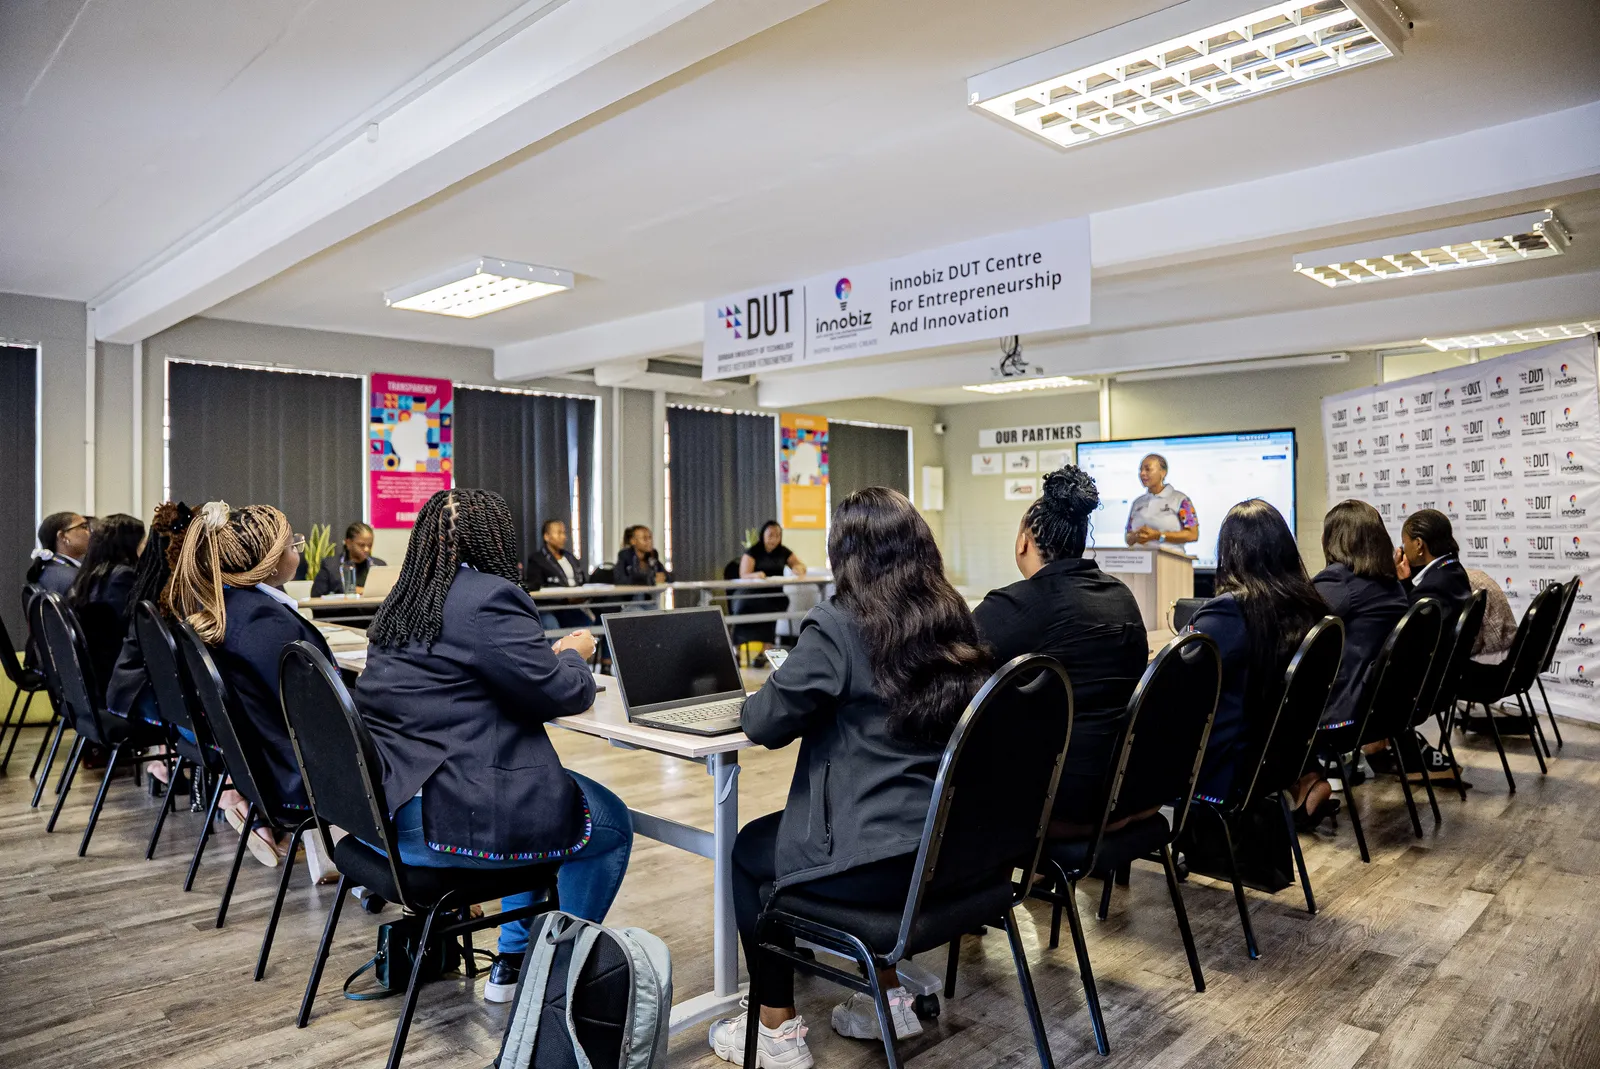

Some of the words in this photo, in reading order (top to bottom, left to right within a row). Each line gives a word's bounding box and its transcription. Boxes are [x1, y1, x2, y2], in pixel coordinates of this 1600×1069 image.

[890, 269, 944, 292] innobiz
[948, 261, 981, 280] DUT
[985, 252, 1042, 273] Centre
[890, 299, 913, 314] For
[918, 271, 1062, 306] Entrepreneurship
[747, 289, 794, 340] DUT
[816, 310, 872, 333] innobiz
[890, 318, 918, 336] And
[923, 306, 1009, 330] Innovation
[1529, 368, 1543, 384] DUT
[1467, 381, 1481, 396] DUT
[1530, 411, 1546, 426] DUT
[1470, 420, 1483, 434] DUT
[995, 430, 1018, 444] OUR
[1022, 425, 1082, 442] PARTNERS
[1471, 460, 1484, 473] DUT
[1533, 453, 1549, 467] DUT
[1473, 499, 1486, 512] DUT
[1535, 496, 1551, 510] DUT
[1475, 537, 1488, 549] DUT
[1537, 537, 1554, 550] DUT
[1568, 636, 1594, 645] innobiz
[1550, 661, 1561, 674] UT
